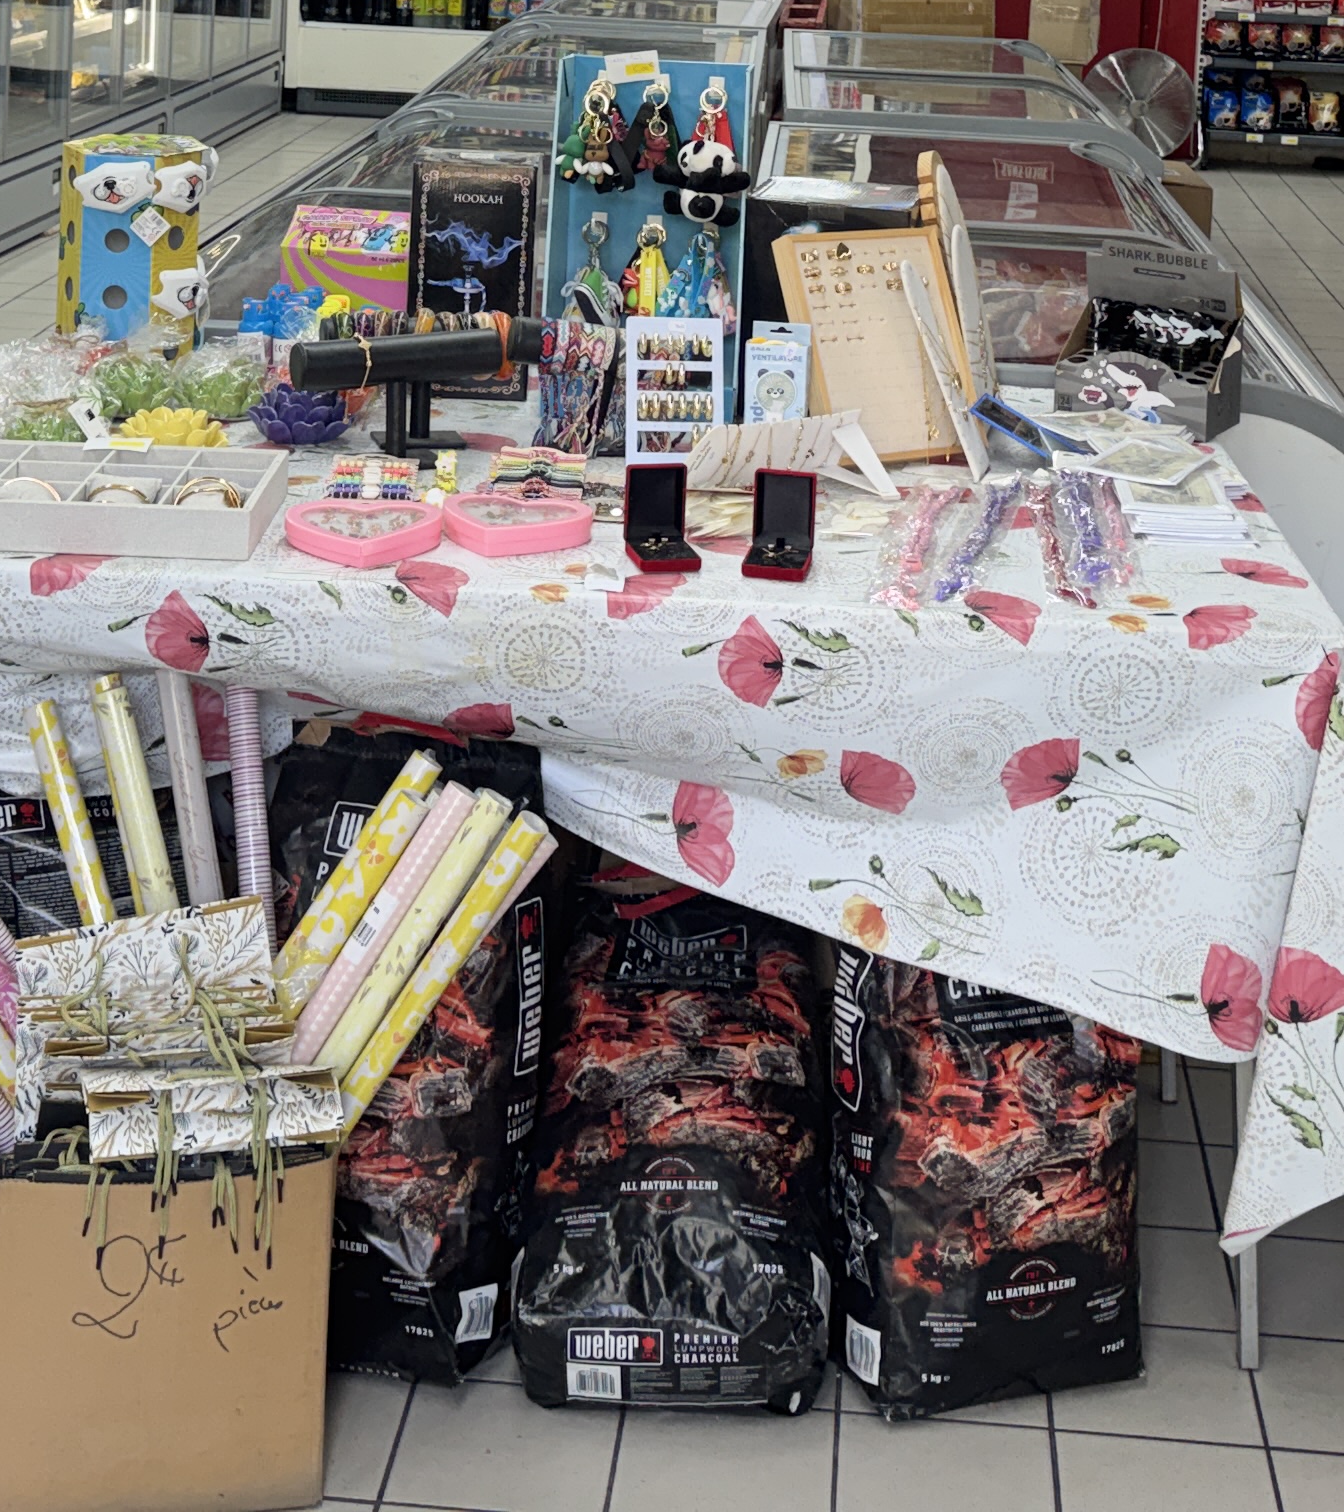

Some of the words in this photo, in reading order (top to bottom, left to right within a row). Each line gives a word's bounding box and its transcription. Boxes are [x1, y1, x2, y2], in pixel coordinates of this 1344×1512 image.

[454, 193, 504, 205] HOOKAH
[523, 944, 544, 1064] weber
[834, 949, 864, 1066] weber
[620, 1181, 639, 1192] ALL
[640, 1180, 684, 1192] NATURAL
[686, 1180, 719, 1191] BLEND
[340, 1239, 369, 1255] BLEND
[986, 1289, 1004, 1302] ALL
[1005, 1286, 1046, 1299] NATURAL
[1047, 1277, 1076, 1291] BLEND
[673, 1332, 740, 1345] PREMIUM
[574, 1330, 640, 1361] weber
[673, 1345, 740, 1354] LUMPWOOD
[673, 1353, 740, 1364] CHARCOAL
[921, 1373, 928, 1383] 5
[930, 1373, 942, 1385] kg
